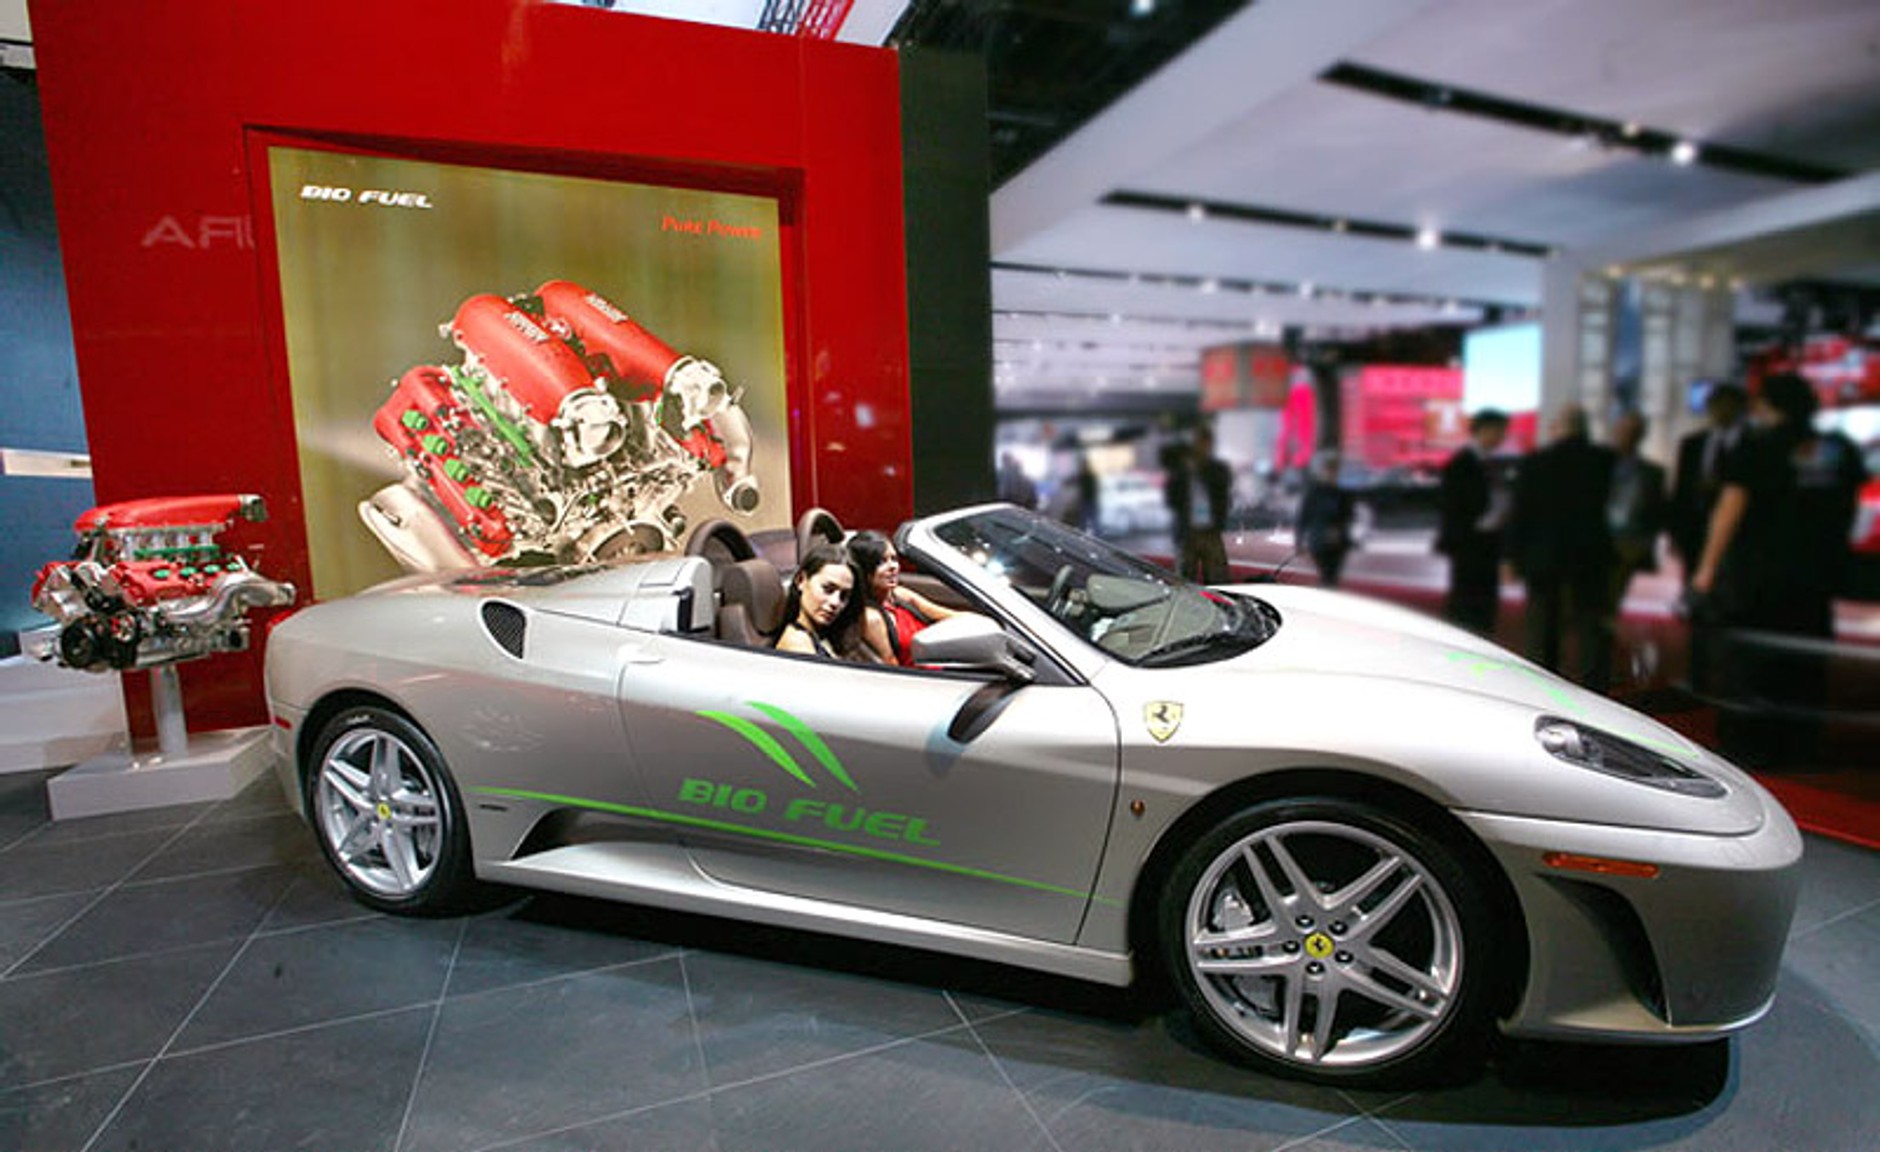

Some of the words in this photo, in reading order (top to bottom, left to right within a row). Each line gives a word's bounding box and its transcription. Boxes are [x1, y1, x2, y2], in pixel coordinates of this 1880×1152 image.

[300, 185, 352, 201] BIO
[358, 188, 433, 208] FUEL
[678, 778, 768, 814] BIO
[784, 799, 941, 847] FUEL
